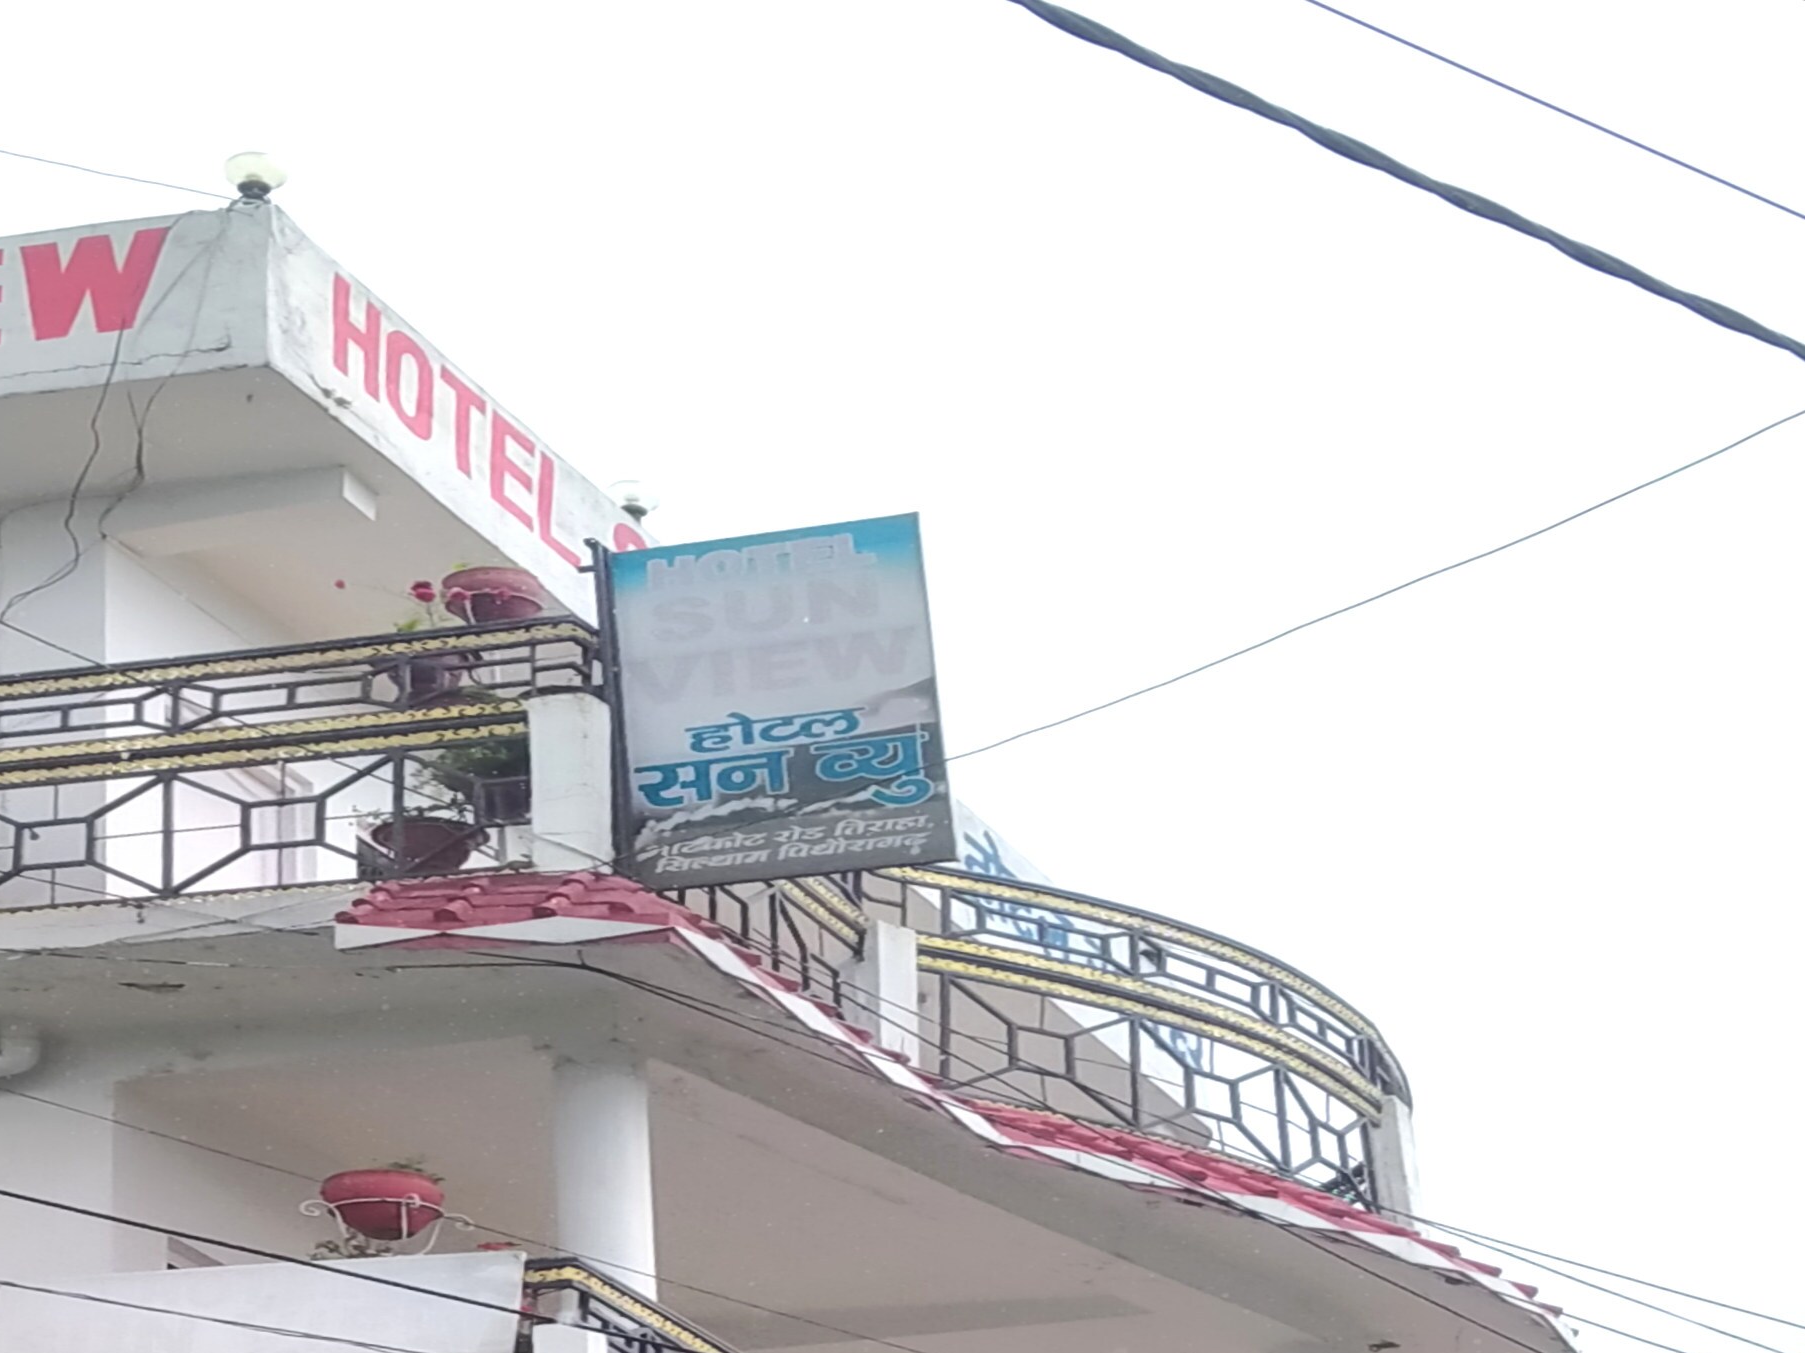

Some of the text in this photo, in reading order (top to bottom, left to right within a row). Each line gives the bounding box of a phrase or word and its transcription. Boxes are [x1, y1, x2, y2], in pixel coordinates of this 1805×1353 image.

[332, 270, 582, 569] HOTEL
[646, 532, 877, 590] HOTEL
[649, 579, 881, 642] SUN
[626, 628, 914, 701] VIEW
[684, 707, 866, 754] होटल
[633, 748, 794, 808] सन
[772, 825, 827, 843] रोड
